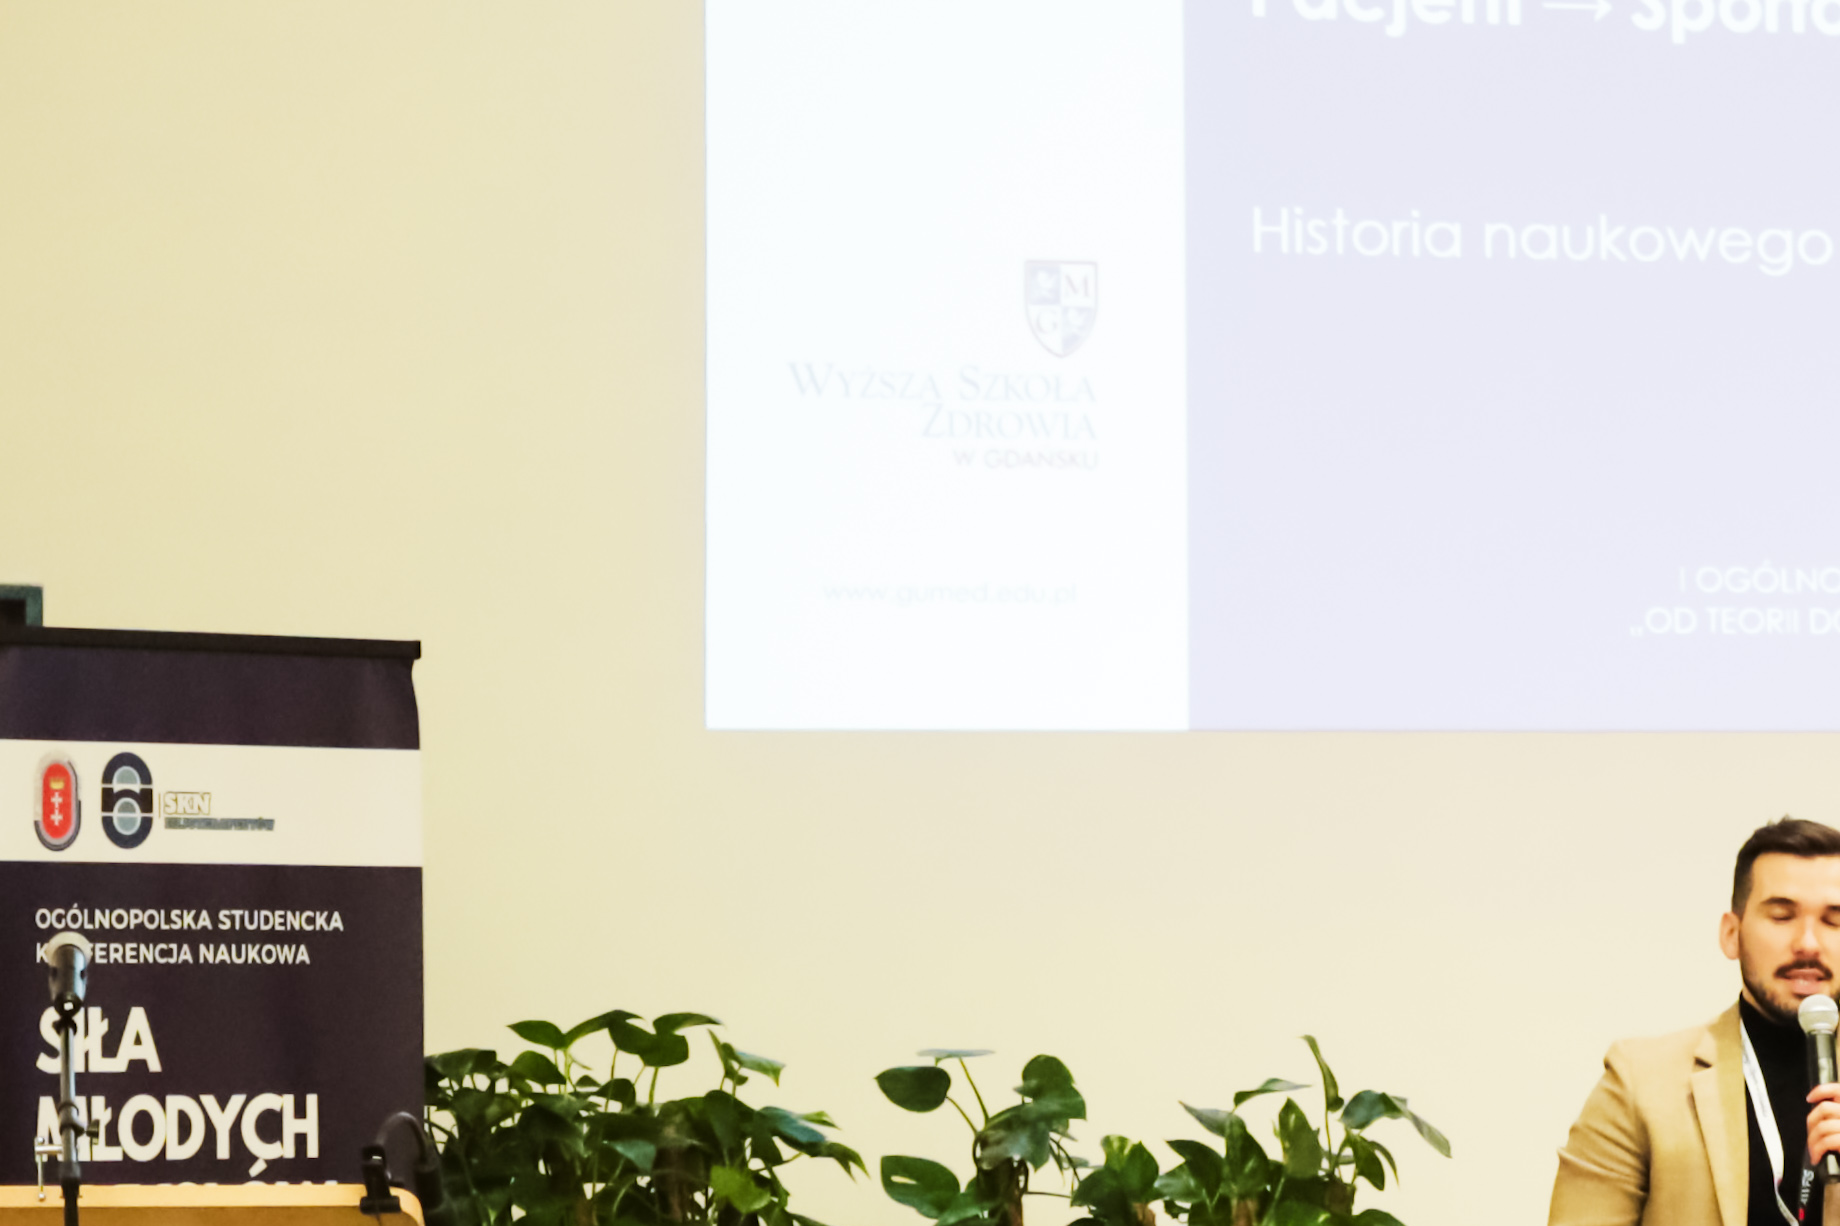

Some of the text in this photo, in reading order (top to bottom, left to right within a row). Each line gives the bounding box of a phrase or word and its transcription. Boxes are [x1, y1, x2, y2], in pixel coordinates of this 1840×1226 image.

[1252, 205, 1462, 258] Historia
[1484, 213, 1834, 277] naukowego
[921, 402, 1097, 440] ZDROWIA
[1706, 606, 1800, 635] TEORII
[35, 902, 344, 932] OGÓLNOPOLSKA STUDENCKA
[198, 943, 311, 965] NAUKOWA
[36, 1005, 163, 1075] SIŁA
[36, 1092, 320, 1163] MŁODYCH
